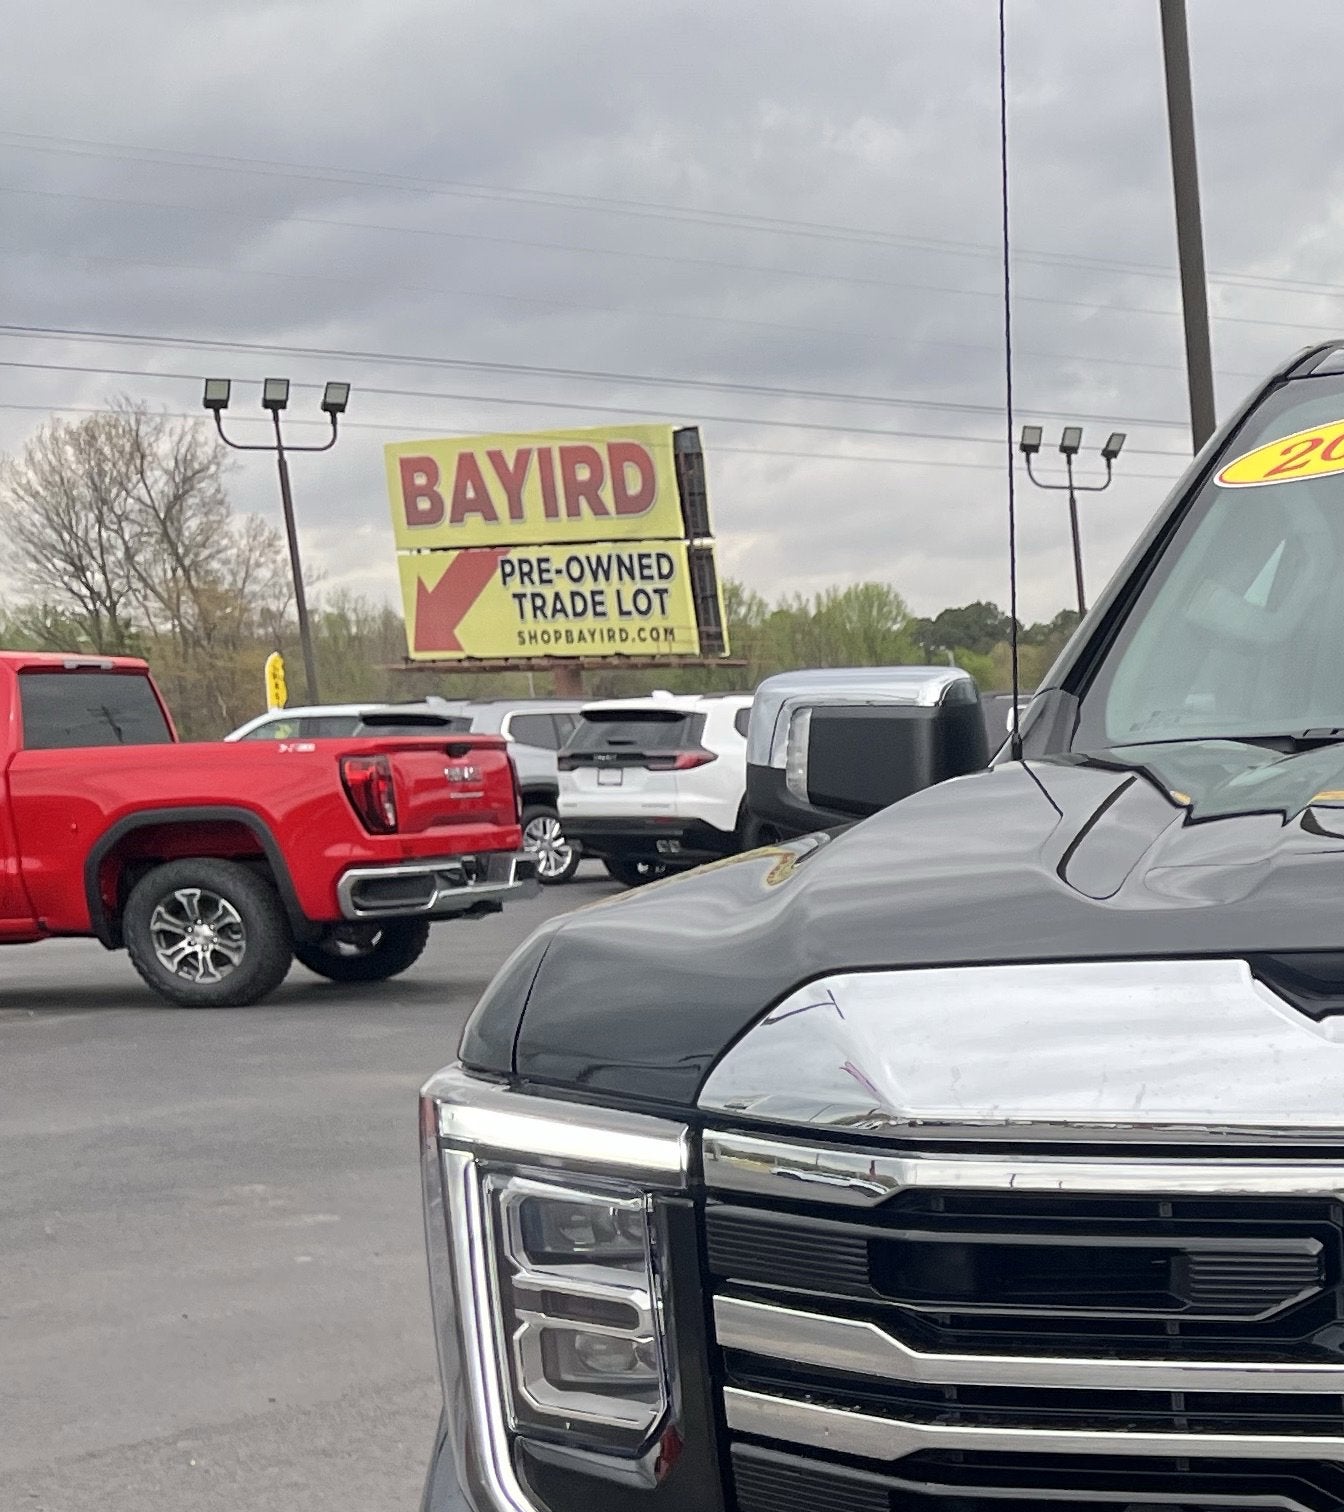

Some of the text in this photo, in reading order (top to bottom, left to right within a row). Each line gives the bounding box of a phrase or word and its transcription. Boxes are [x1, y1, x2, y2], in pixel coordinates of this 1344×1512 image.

[398, 441, 657, 528] BAYIRD
[500, 552, 674, 586] PRE-OWNED
[512, 588, 669, 620] TRADE LOT
[517, 626, 676, 646] SHOPBAYIRD.COM
